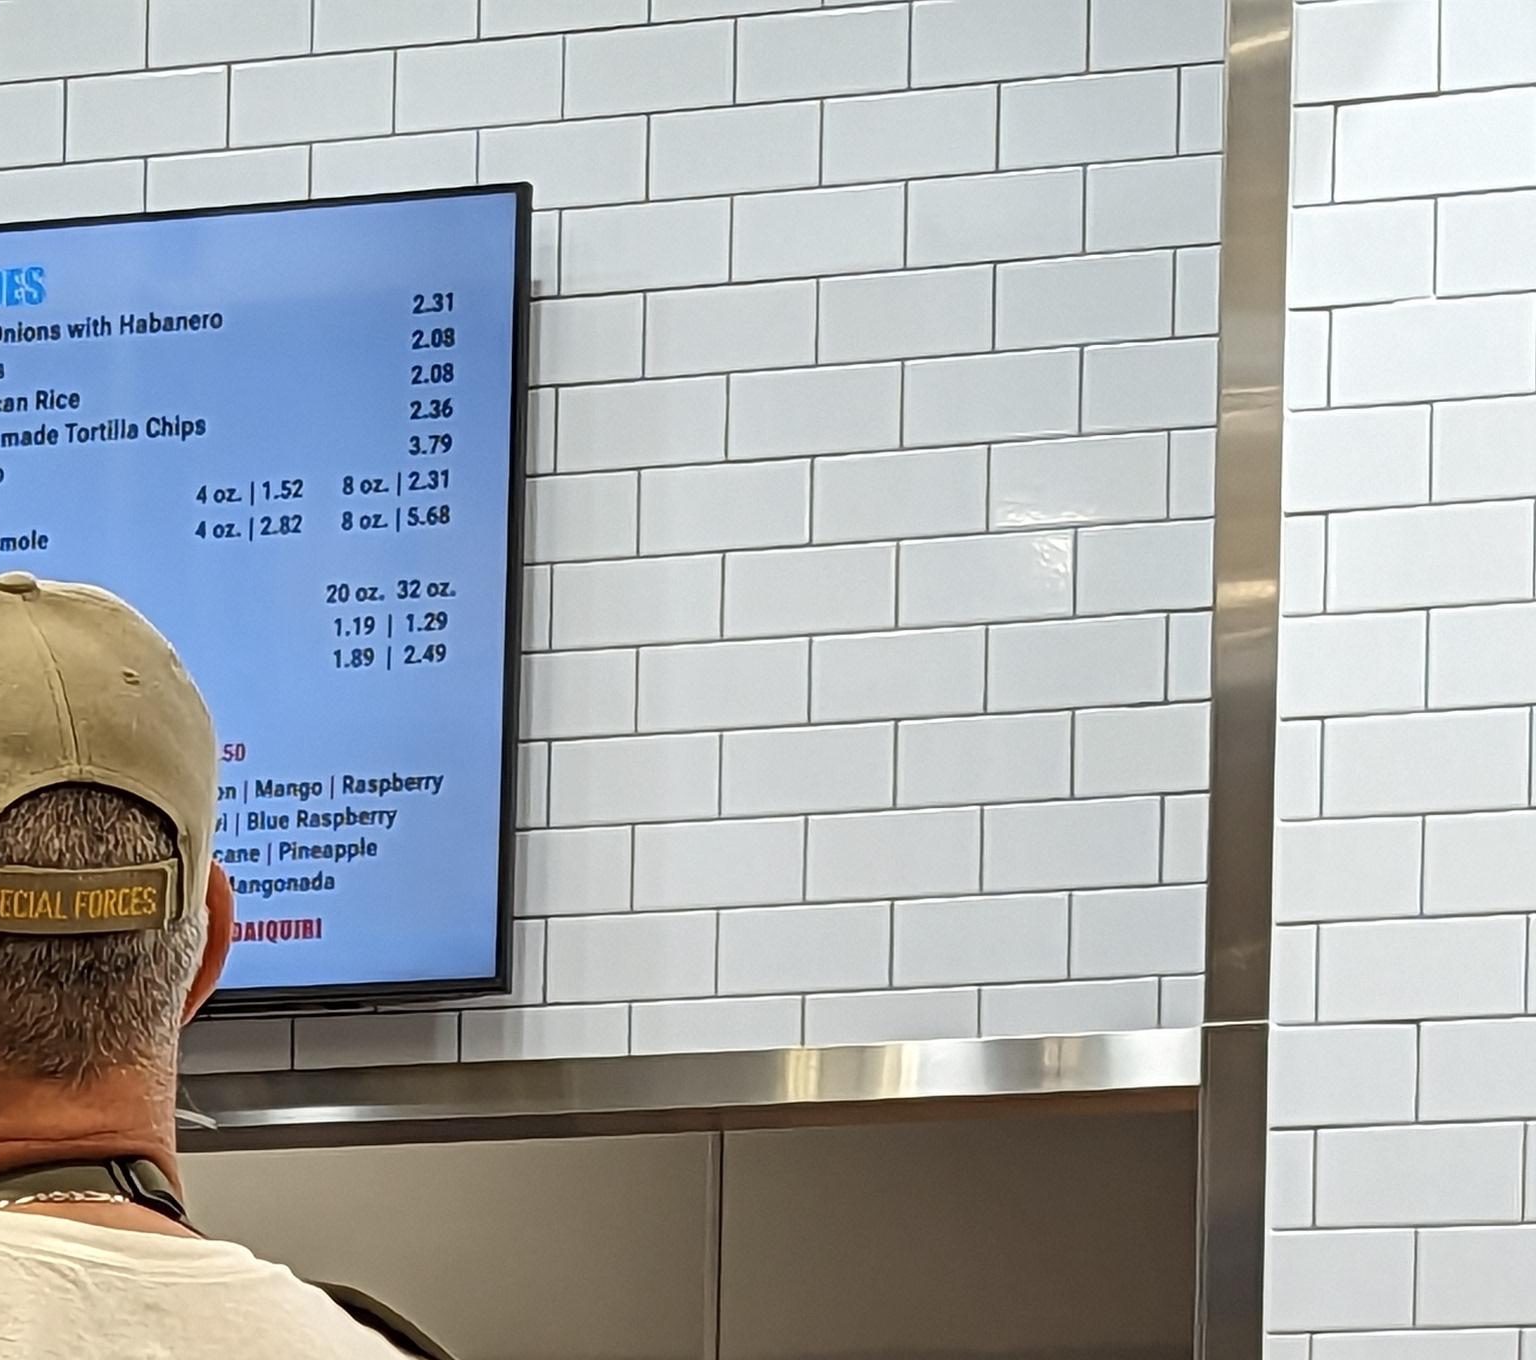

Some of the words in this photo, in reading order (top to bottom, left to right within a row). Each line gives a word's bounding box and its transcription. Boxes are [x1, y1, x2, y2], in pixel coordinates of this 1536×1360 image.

[67, 315, 112, 339] with
[120, 311, 223, 336] Habanero
[412, 292, 454, 315] 2.31
[410, 327, 456, 350] 2.08
[35, 389, 81, 411] Rice
[410, 362, 454, 385] 2.08
[65, 419, 139, 443] Tortilla
[146, 415, 207, 442] Chips
[409, 398, 453, 420] 2.36
[408, 433, 452, 456] 3.79
[196, 485, 208, 505] 4
[262, 479, 304, 500] 1.52
[342, 475, 354, 495] 8
[408, 469, 450, 491] 2.31
[195, 520, 207, 539] 4
[212, 523, 241, 539] oz.
[259, 514, 302, 536] 2.82
[341, 511, 353, 531] 8
[407, 505, 450, 527] 5.68
[326, 583, 350, 604] 20
[355, 586, 385, 602] oz.
[397, 579, 421, 599] 32
[426, 581, 456, 598] oz.
[334, 615, 375, 637] 1.19
[406, 611, 448, 632] 1.29
[333, 647, 374, 668] 1.89
[404, 643, 447, 664] 2.49
[255, 779, 323, 801] Mango
[342, 772, 445, 798] Raspberry
[247, 810, 289, 831] Blue
[296, 806, 398, 831] Raspberry
[279, 837, 378, 863] Pineapple
[75, 886, 157, 919] FORCES
